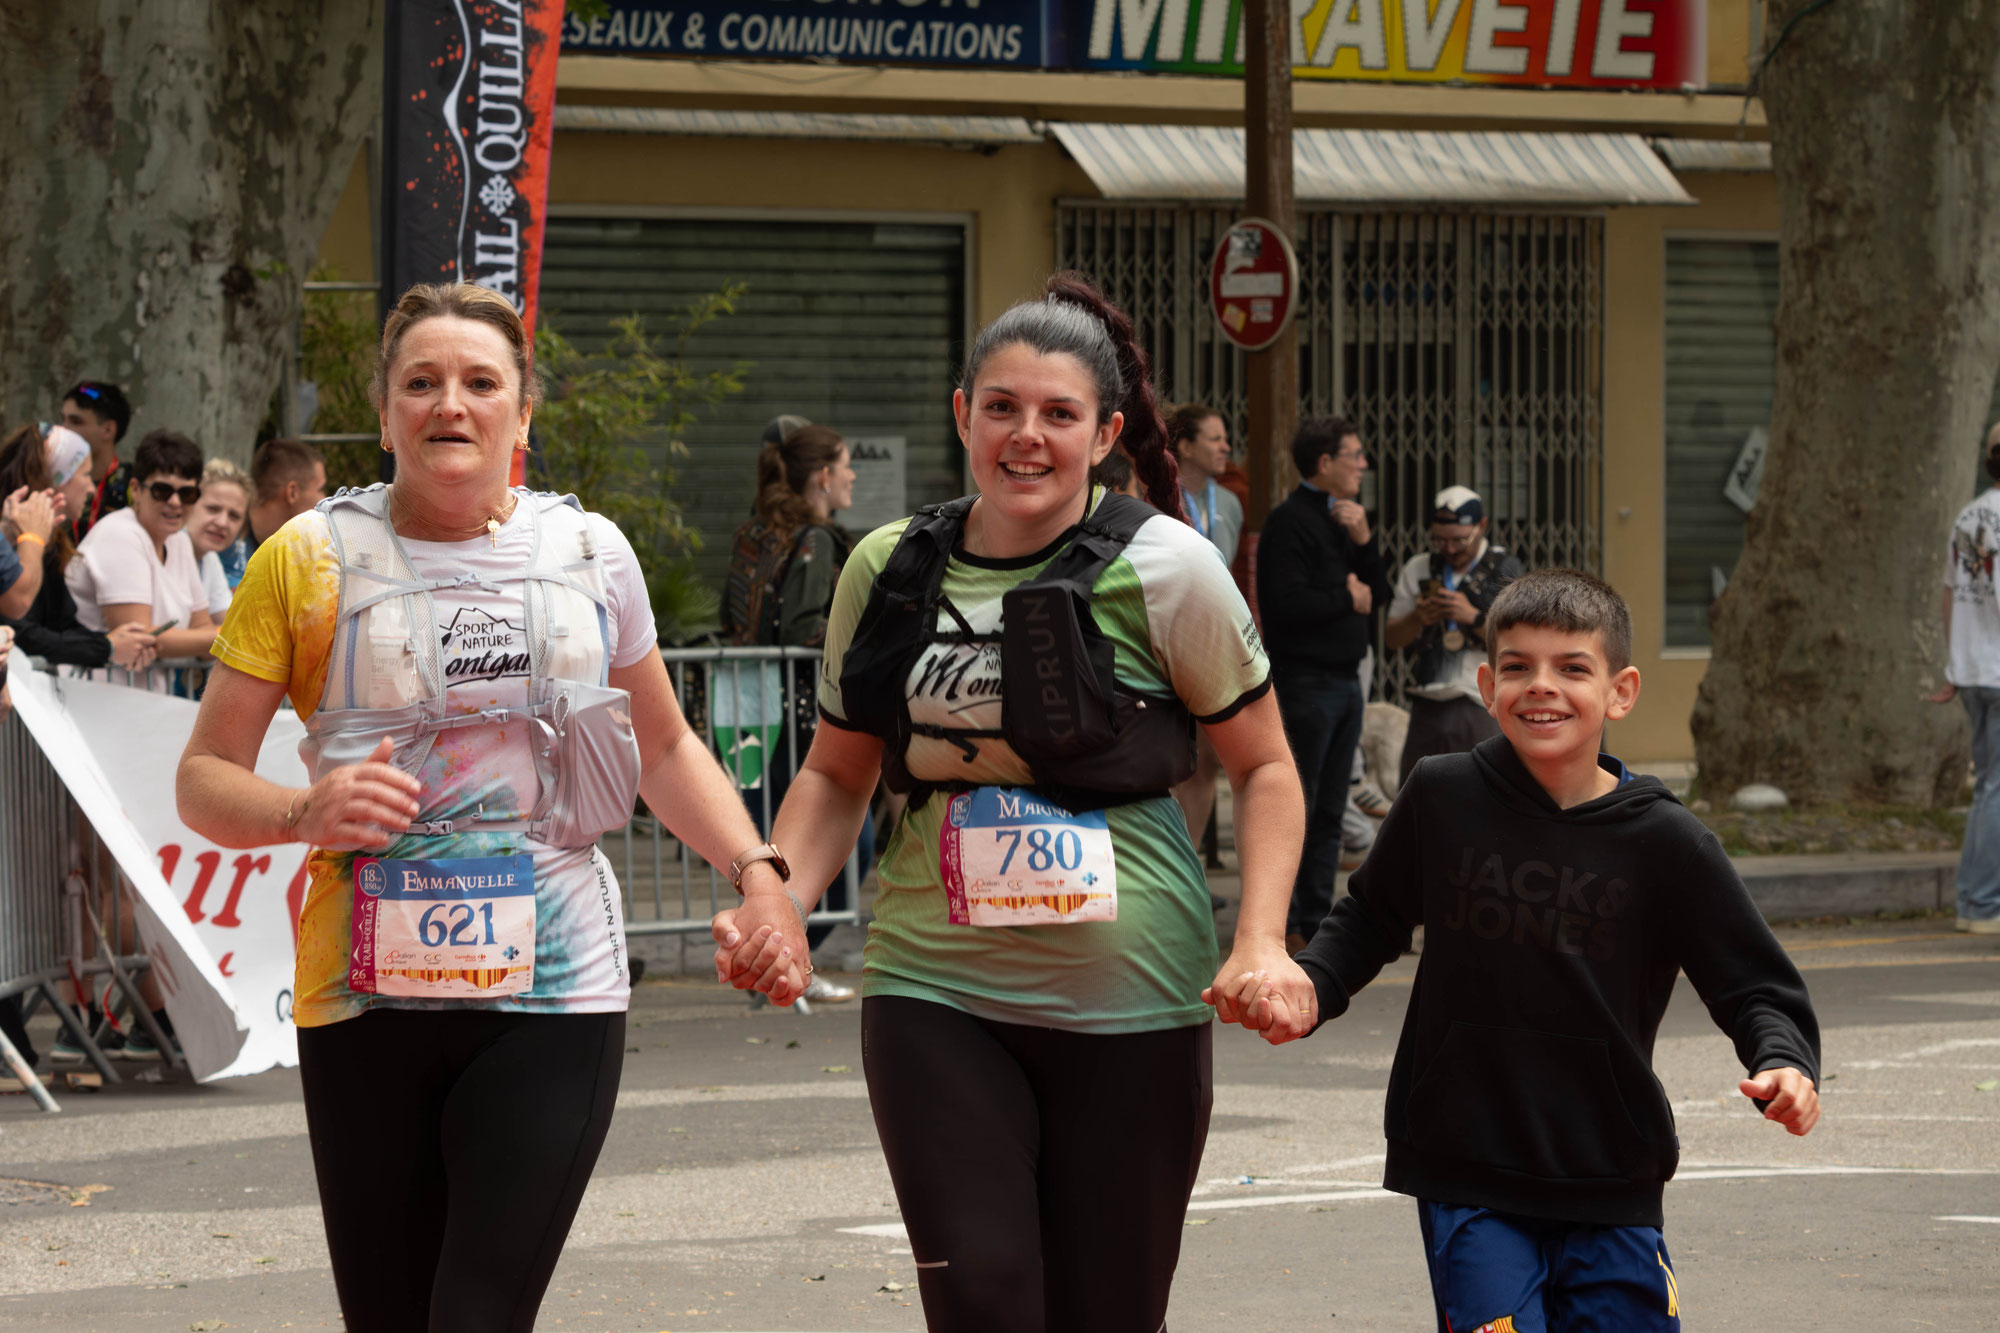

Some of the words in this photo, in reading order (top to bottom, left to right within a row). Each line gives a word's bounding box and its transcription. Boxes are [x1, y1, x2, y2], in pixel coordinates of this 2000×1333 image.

[682, 13, 707, 50] &
[718, 13, 1023, 60] COMMUNICATIONS
[455, 622, 496, 637] SPORT
[462, 633, 514, 651] NATURE
[1022, 595, 1077, 744] KIPRUN
[996, 828, 1082, 875] 780
[596, 866, 614, 926] NATURE
[363, 900, 376, 939] QUILLAN
[418, 902, 498, 947] 621
[1440, 888, 1617, 961] JONES
[351, 968, 367, 980] 26
[363, 940, 373, 967] TRAIL
[609, 931, 624, 977] SPORT
